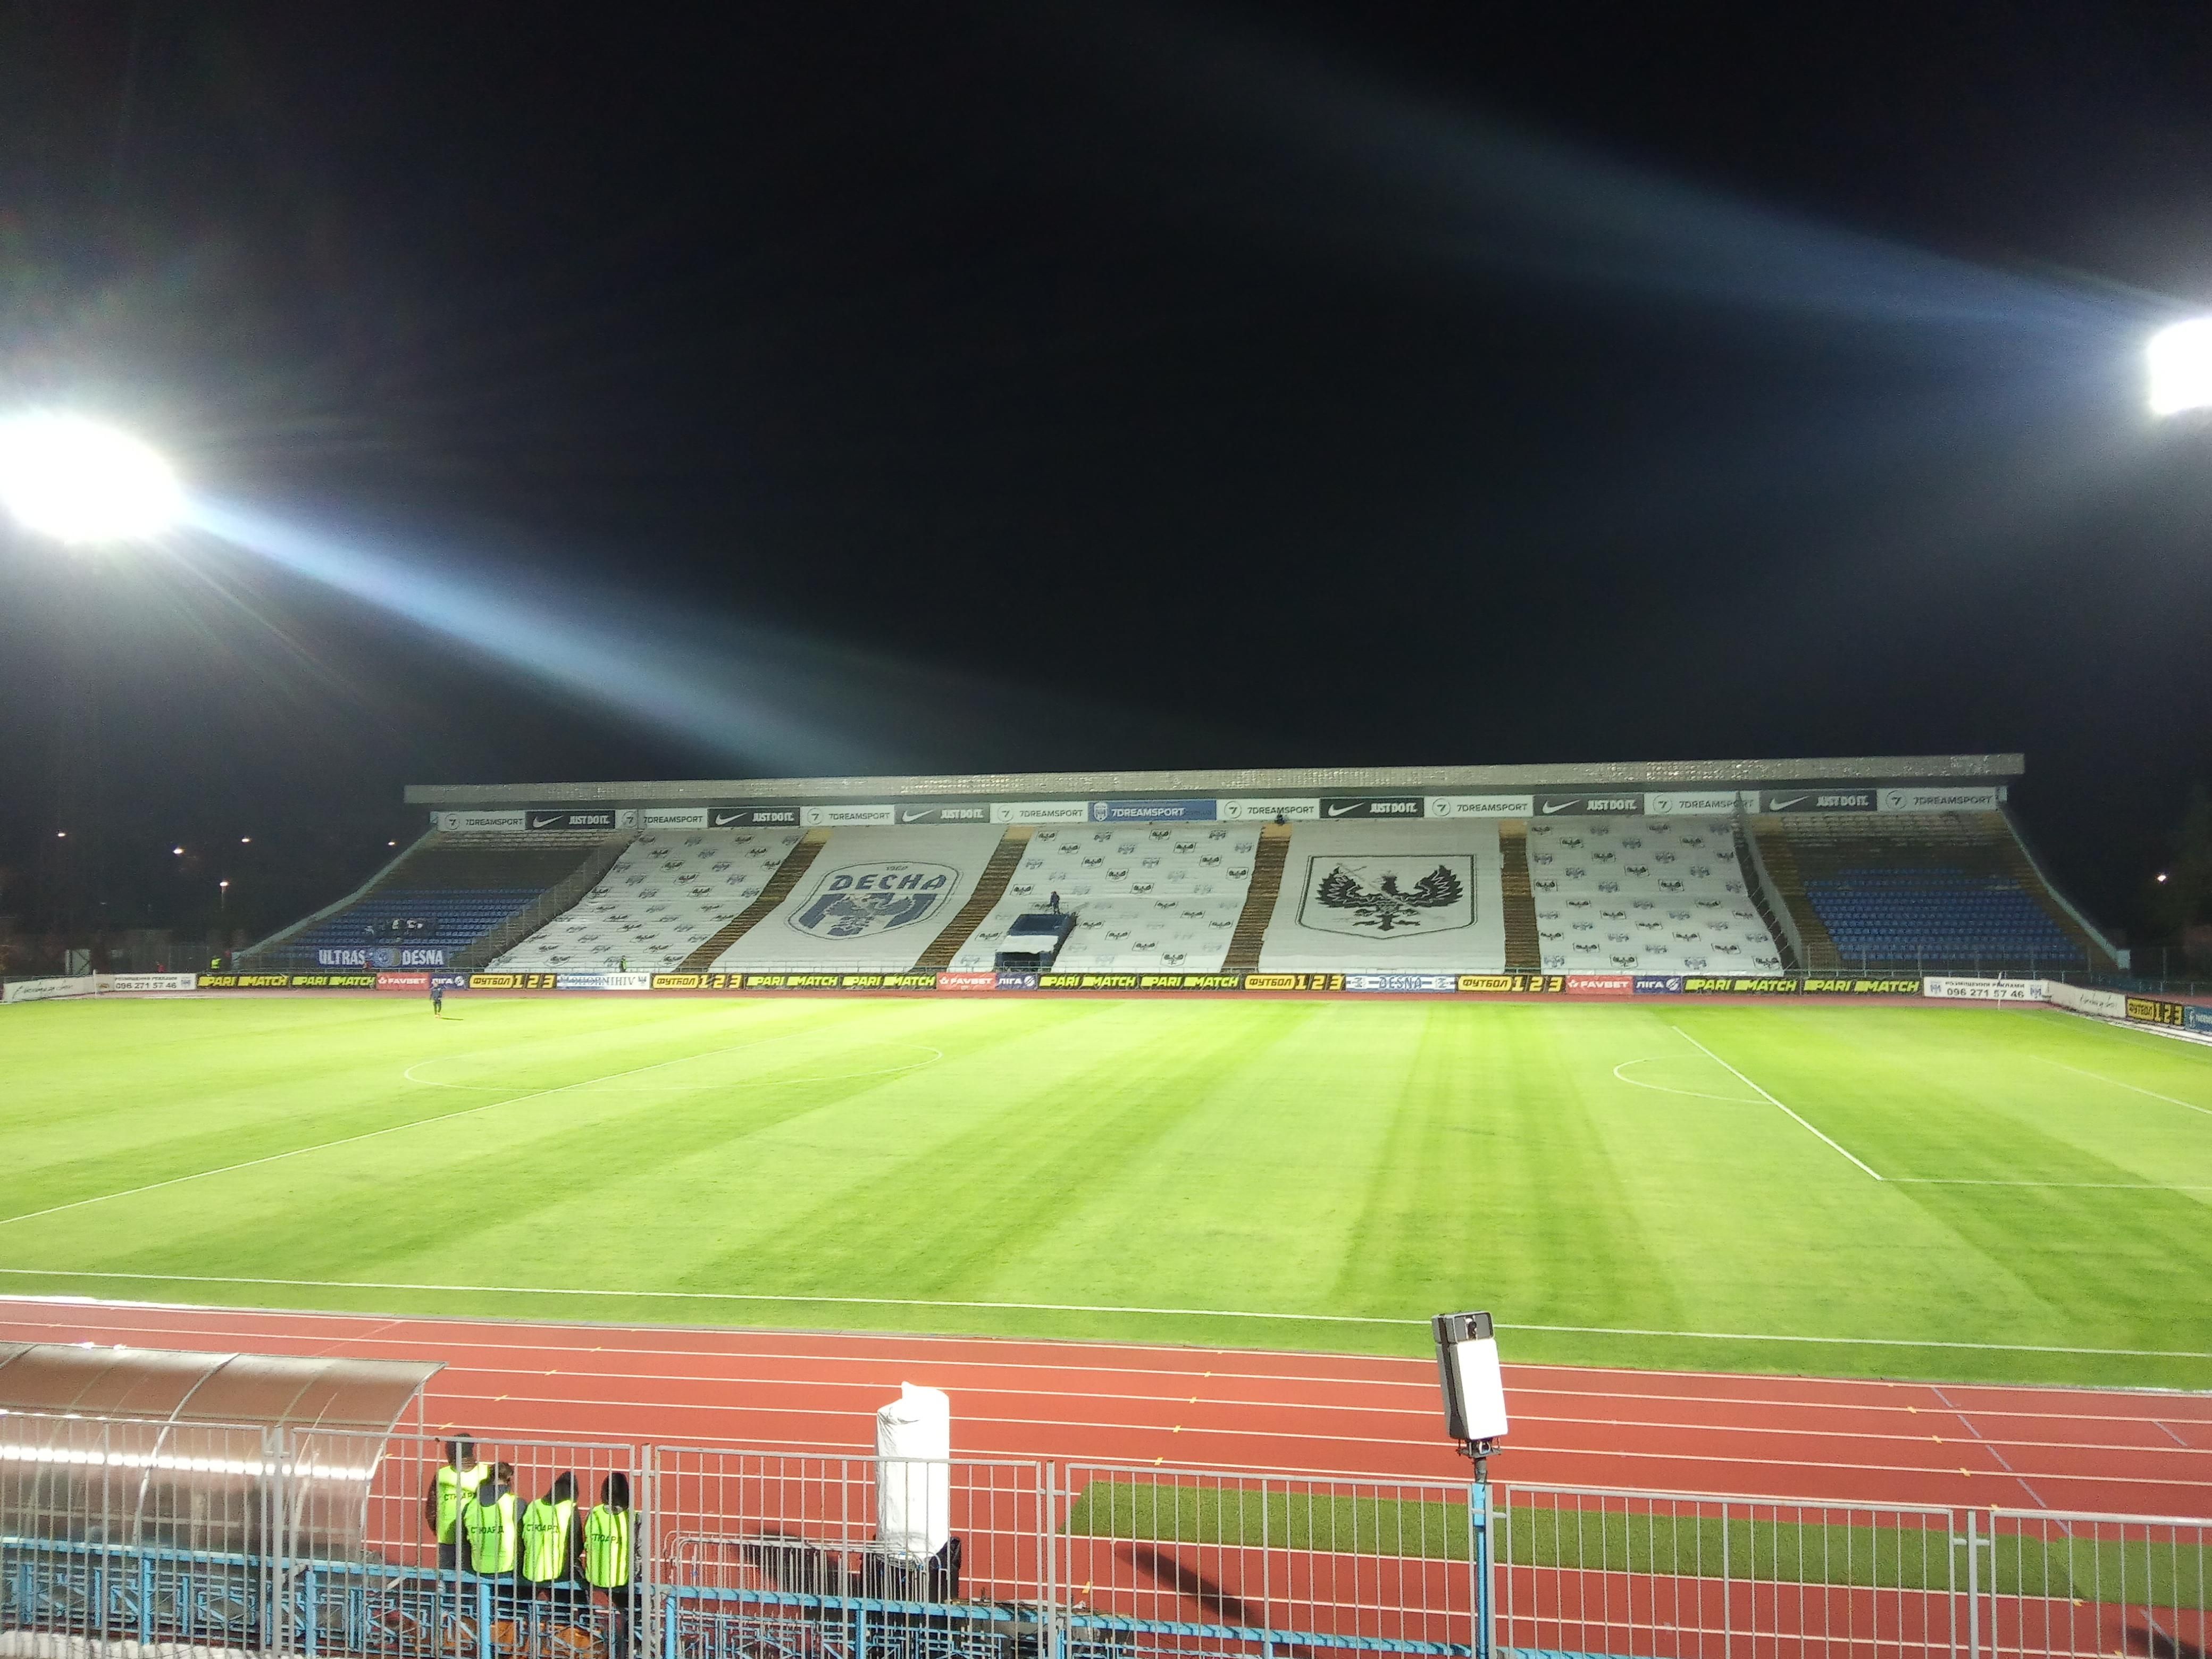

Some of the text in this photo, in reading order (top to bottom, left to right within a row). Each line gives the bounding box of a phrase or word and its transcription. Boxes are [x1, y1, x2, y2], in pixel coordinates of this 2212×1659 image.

[1587, 800, 1608, 810] JUST
[1610, 799, 1624, 810] DO
[1679, 800, 1754, 808] 7DREAMSPT
[1816, 796, 1840, 806] JUST
[1840, 795, 1856, 806] DO
[1914, 795, 1992, 805] 7DREAMSPORT
[1111, 807, 1186, 817] 7DREAMSPORT
[1370, 803, 1391, 812] JUST
[1391, 802, 1405, 813] DO
[1457, 803, 1528, 812] 7DREAMSPORT
[752, 812, 771, 822] JUST
[771, 812, 783, 821] DO
[941, 809, 960, 818] JUST
[960, 809, 973, 818] DO
[569, 815, 586, 824] JUST
[588, 815, 599, 824] DO
[828, 874, 947, 891] ДЕСНА
[319, 949, 444, 965] ULTRAS DESNA
[207, 976, 289, 986] PARI MATCH
[301, 976, 375, 986] PARI MATCH
[513, 975, 523, 988] 1
[527, 975, 539, 988] 2
[542, 975, 555, 988] 3
[657, 975, 742, 988] ФУТБОЛ 1 2 3
[757, 976, 838, 986] PARI MATCH
[852, 976, 935, 986] PARI MATCH
[1049, 976, 1135, 986] PARI MATCH
[1152, 977, 1239, 987] PARI MATCH
[1295, 976, 1306, 989] 1
[1311, 976, 1326, 990] 2
[1329, 976, 1343, 991] 3
[1379, 976, 1422, 989] DESNA
[1463, 977, 1562, 992] ФУТБОЛ 1 2 3
[1697, 979, 1797, 992] PARI MATCH
[1815, 979, 1919, 992] PARI MATCH
[1971, 988, 1989, 997] 271
[2155, 1003, 2161, 1022] 1
[2164, 1004, 2171, 1023] 2
[2174, 1006, 2182, 1025] 3
[444, 1492, 475, 1501] СТАР
